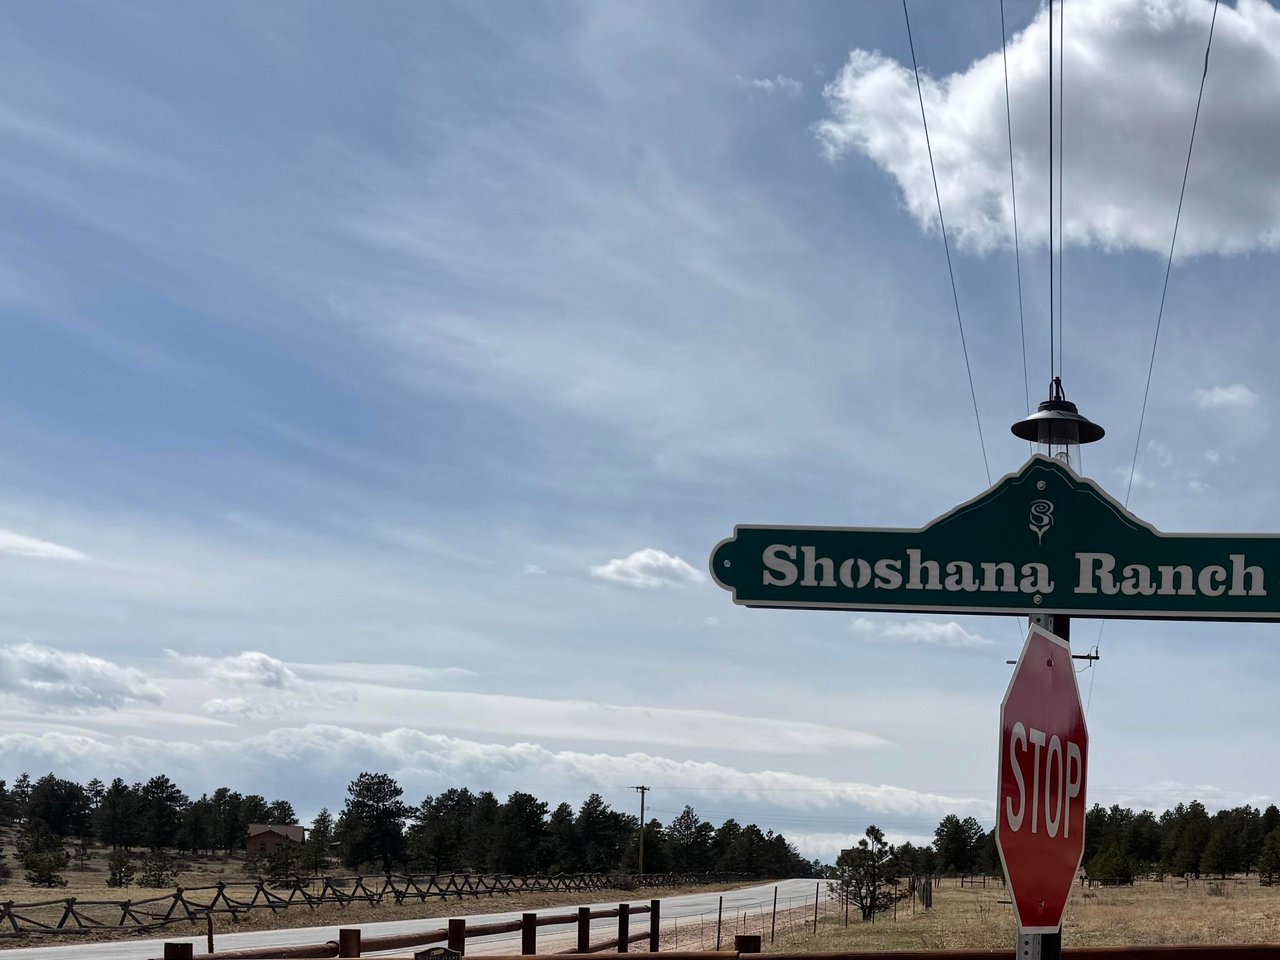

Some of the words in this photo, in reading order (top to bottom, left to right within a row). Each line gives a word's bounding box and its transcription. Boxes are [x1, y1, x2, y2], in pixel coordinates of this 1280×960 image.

[762, 543, 1055, 594] Shoshana
[1073, 552, 1267, 597] Ranch
[1006, 721, 1082, 839] STOP
